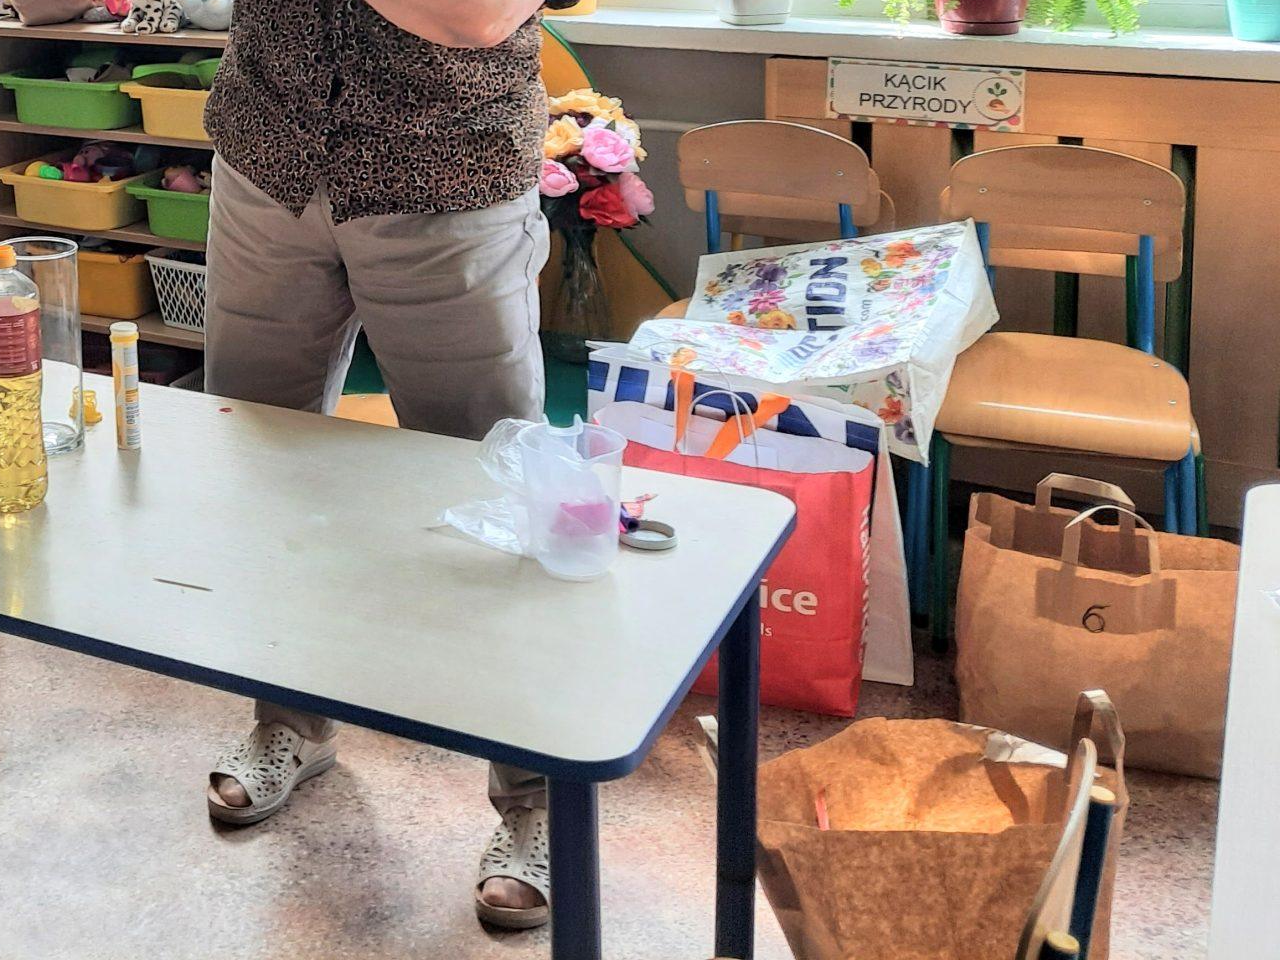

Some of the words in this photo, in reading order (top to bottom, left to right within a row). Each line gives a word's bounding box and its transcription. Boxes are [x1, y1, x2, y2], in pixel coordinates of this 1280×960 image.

[884, 73, 947, 93] KĄCIK
[859, 92, 972, 114] PRZYRODY
[760, 579, 818, 616] ice
[1082, 604, 1111, 633] 6
